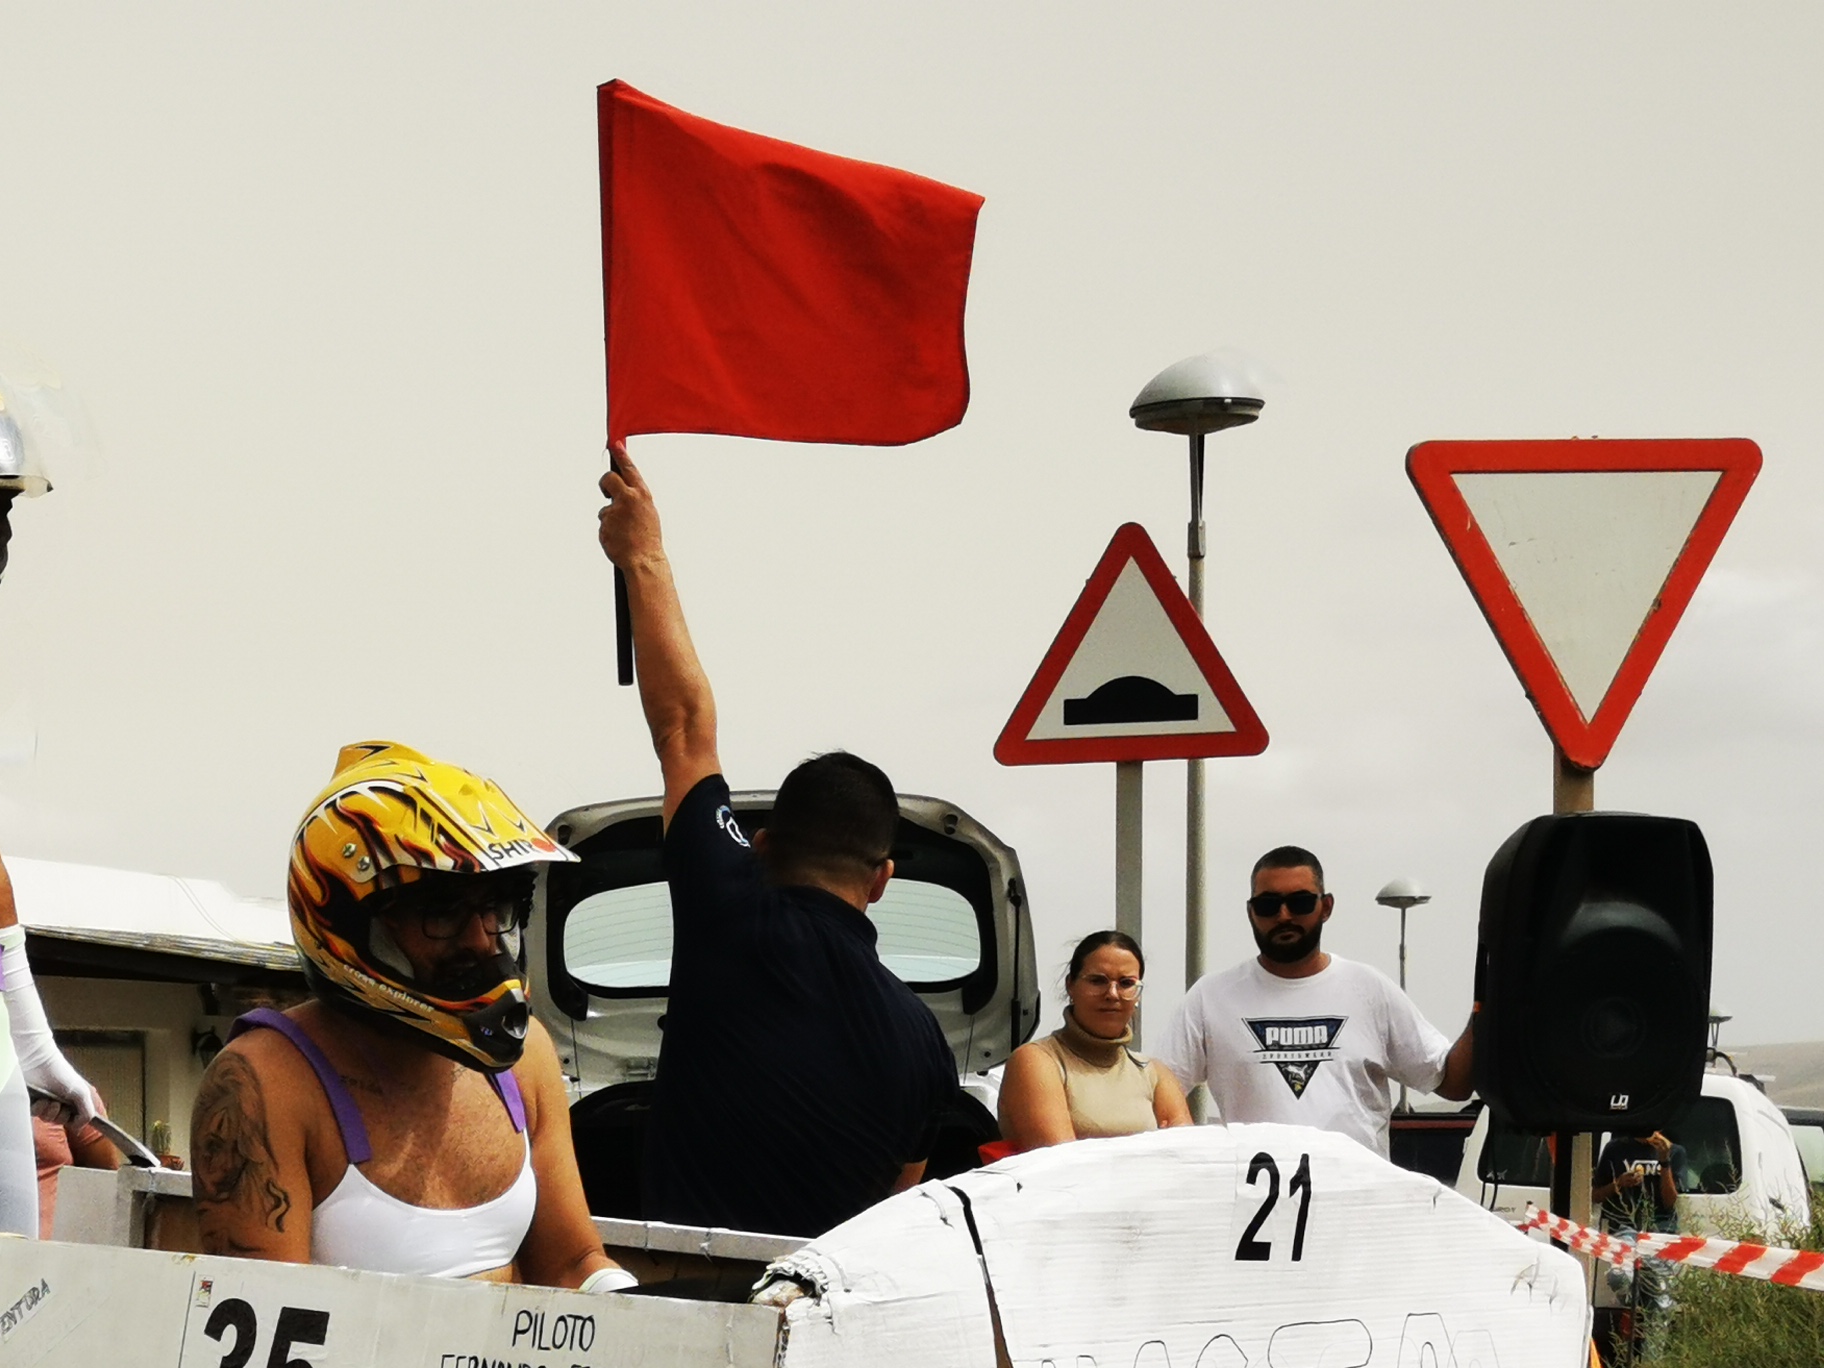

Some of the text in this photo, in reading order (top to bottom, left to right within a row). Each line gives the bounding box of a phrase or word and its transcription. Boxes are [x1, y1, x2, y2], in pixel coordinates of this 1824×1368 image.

[1265, 1025, 1328, 1046] PUMA
[1622, 1159, 1662, 1176] VNS
[1235, 1152, 1312, 1261] 21
[512, 1309, 595, 1352] PILOTO
